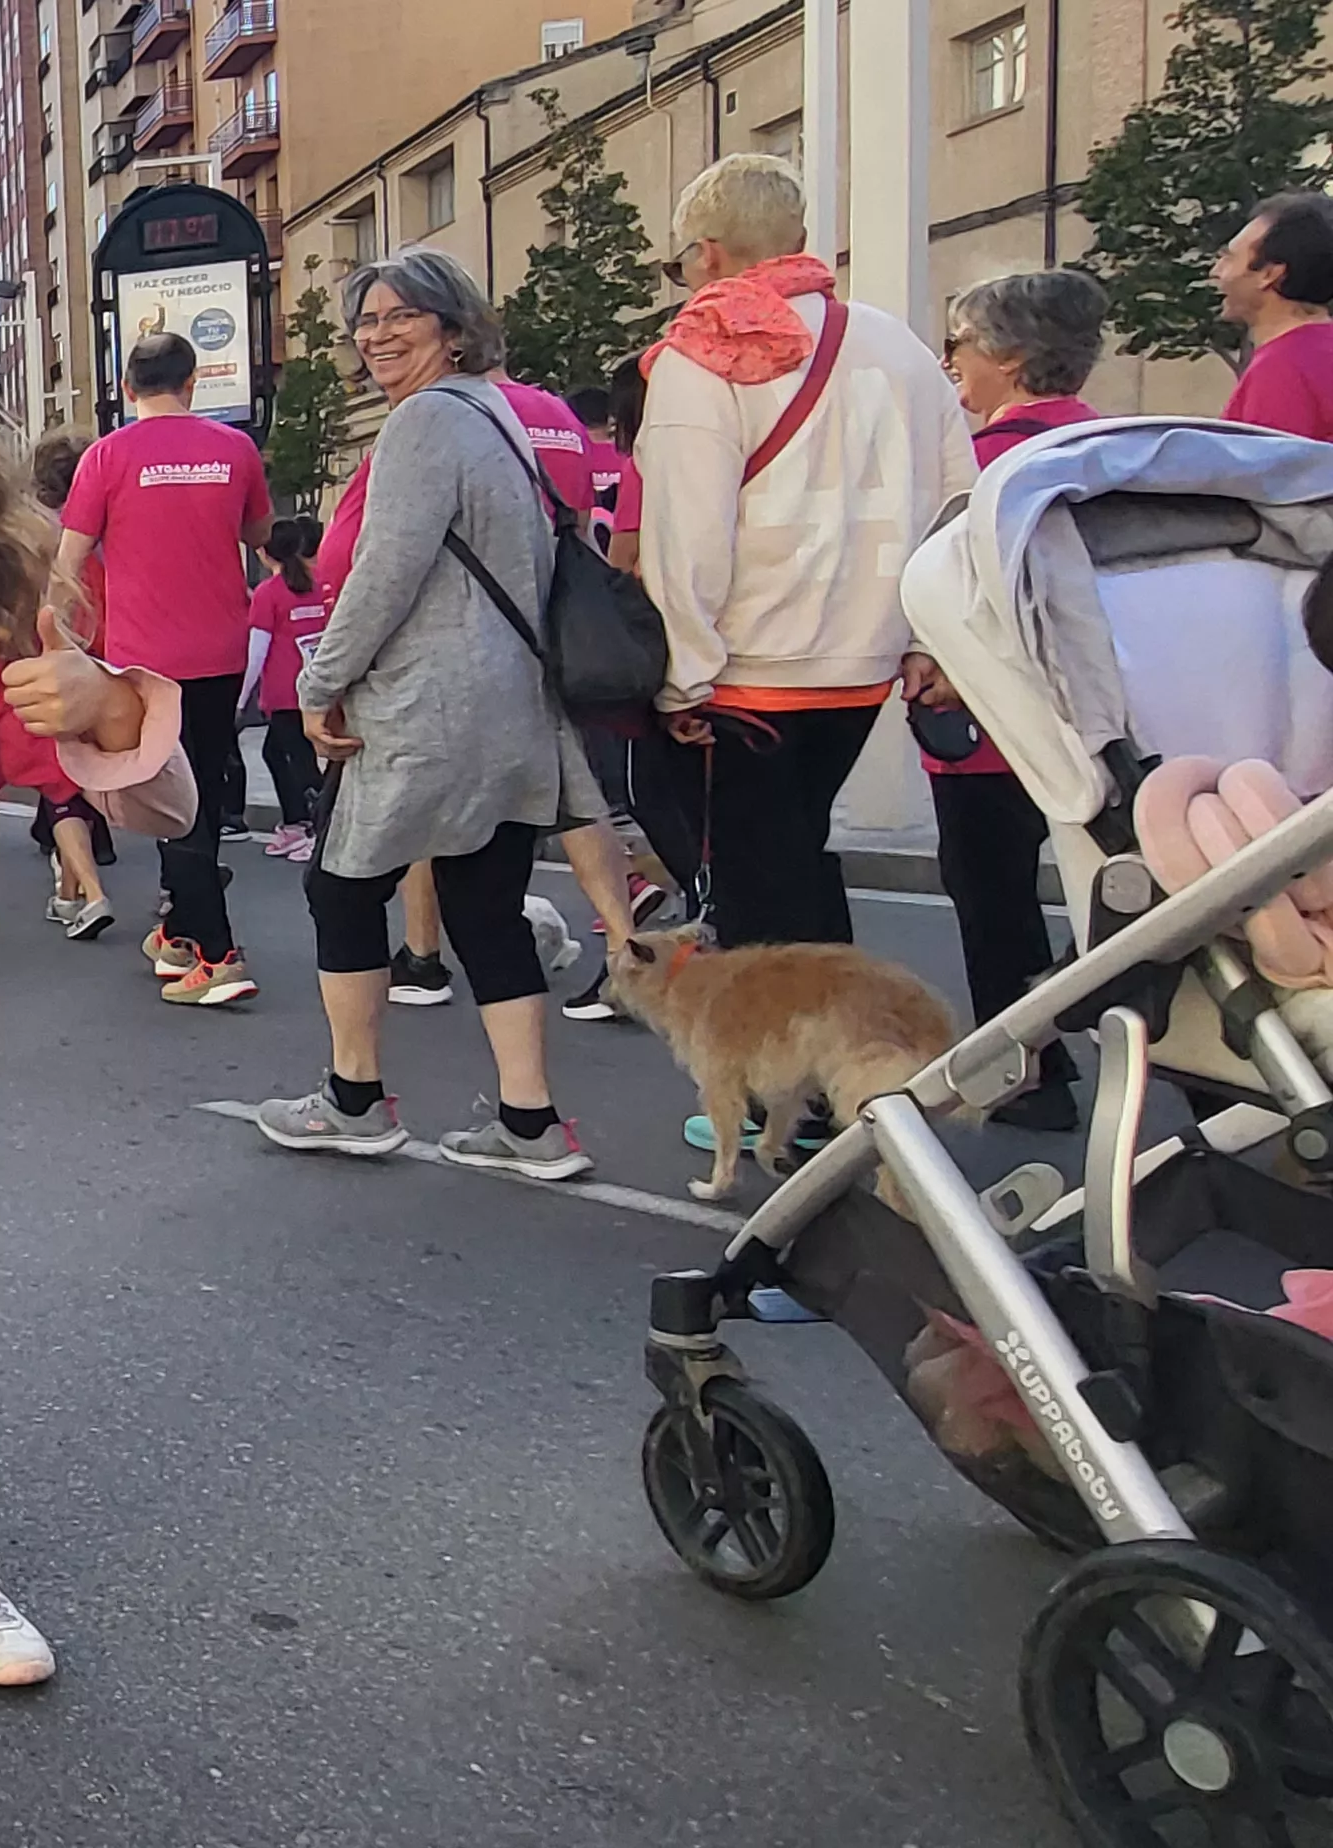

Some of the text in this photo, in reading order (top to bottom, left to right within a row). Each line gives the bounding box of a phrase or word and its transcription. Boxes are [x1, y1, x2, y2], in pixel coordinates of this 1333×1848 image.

[134, 273, 208, 289] HAZ CRECER
[159, 282, 232, 298] TU NEGOCIO
[140, 460, 231, 476] ALTOARAGÓN
